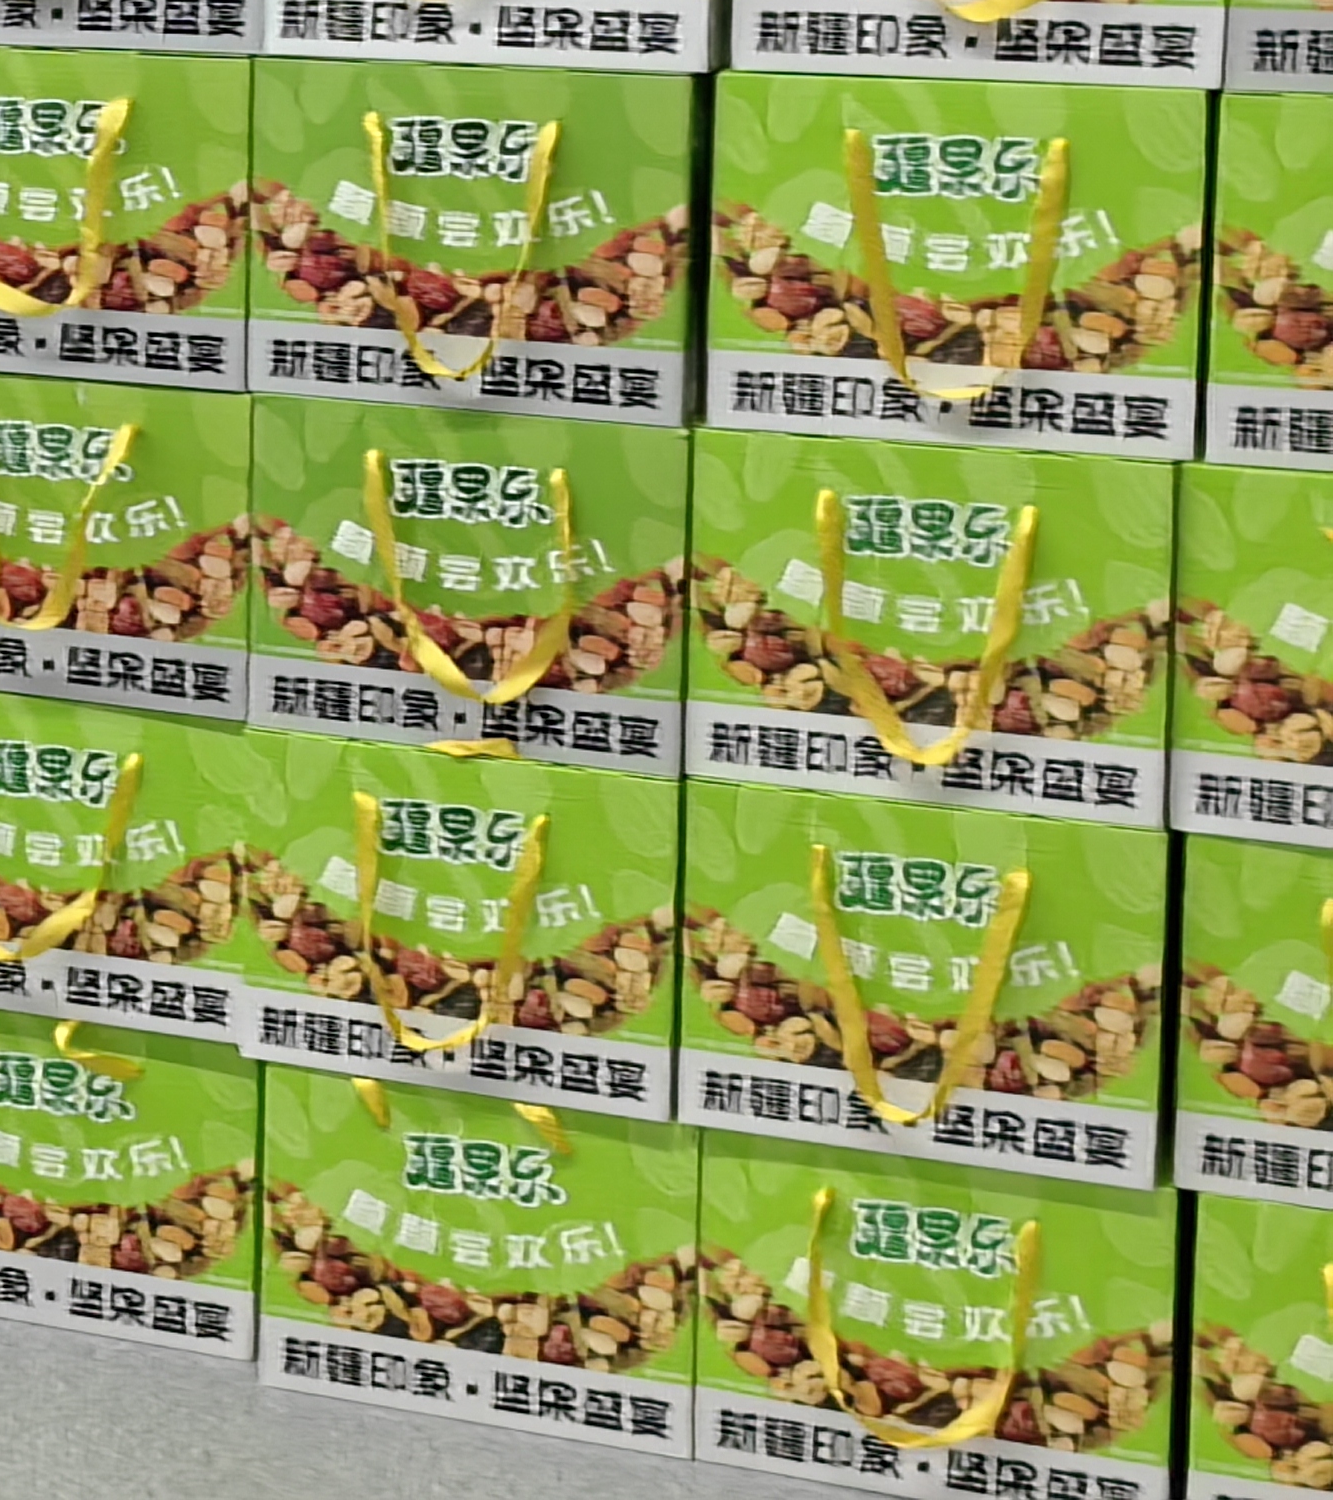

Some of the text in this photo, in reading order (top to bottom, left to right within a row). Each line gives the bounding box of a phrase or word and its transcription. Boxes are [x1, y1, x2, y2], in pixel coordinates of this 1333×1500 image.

[755, 9, 1198, 72] 新疆印象·坚果盛宴
[388, 458, 555, 529] 疆果乐
[272, 675, 662, 759] 新疆印象·坚果盛宴
[402, 1132, 569, 1209] 疆果乐
[280, 1336, 672, 1440] 新疆印象·坚果盛宴
